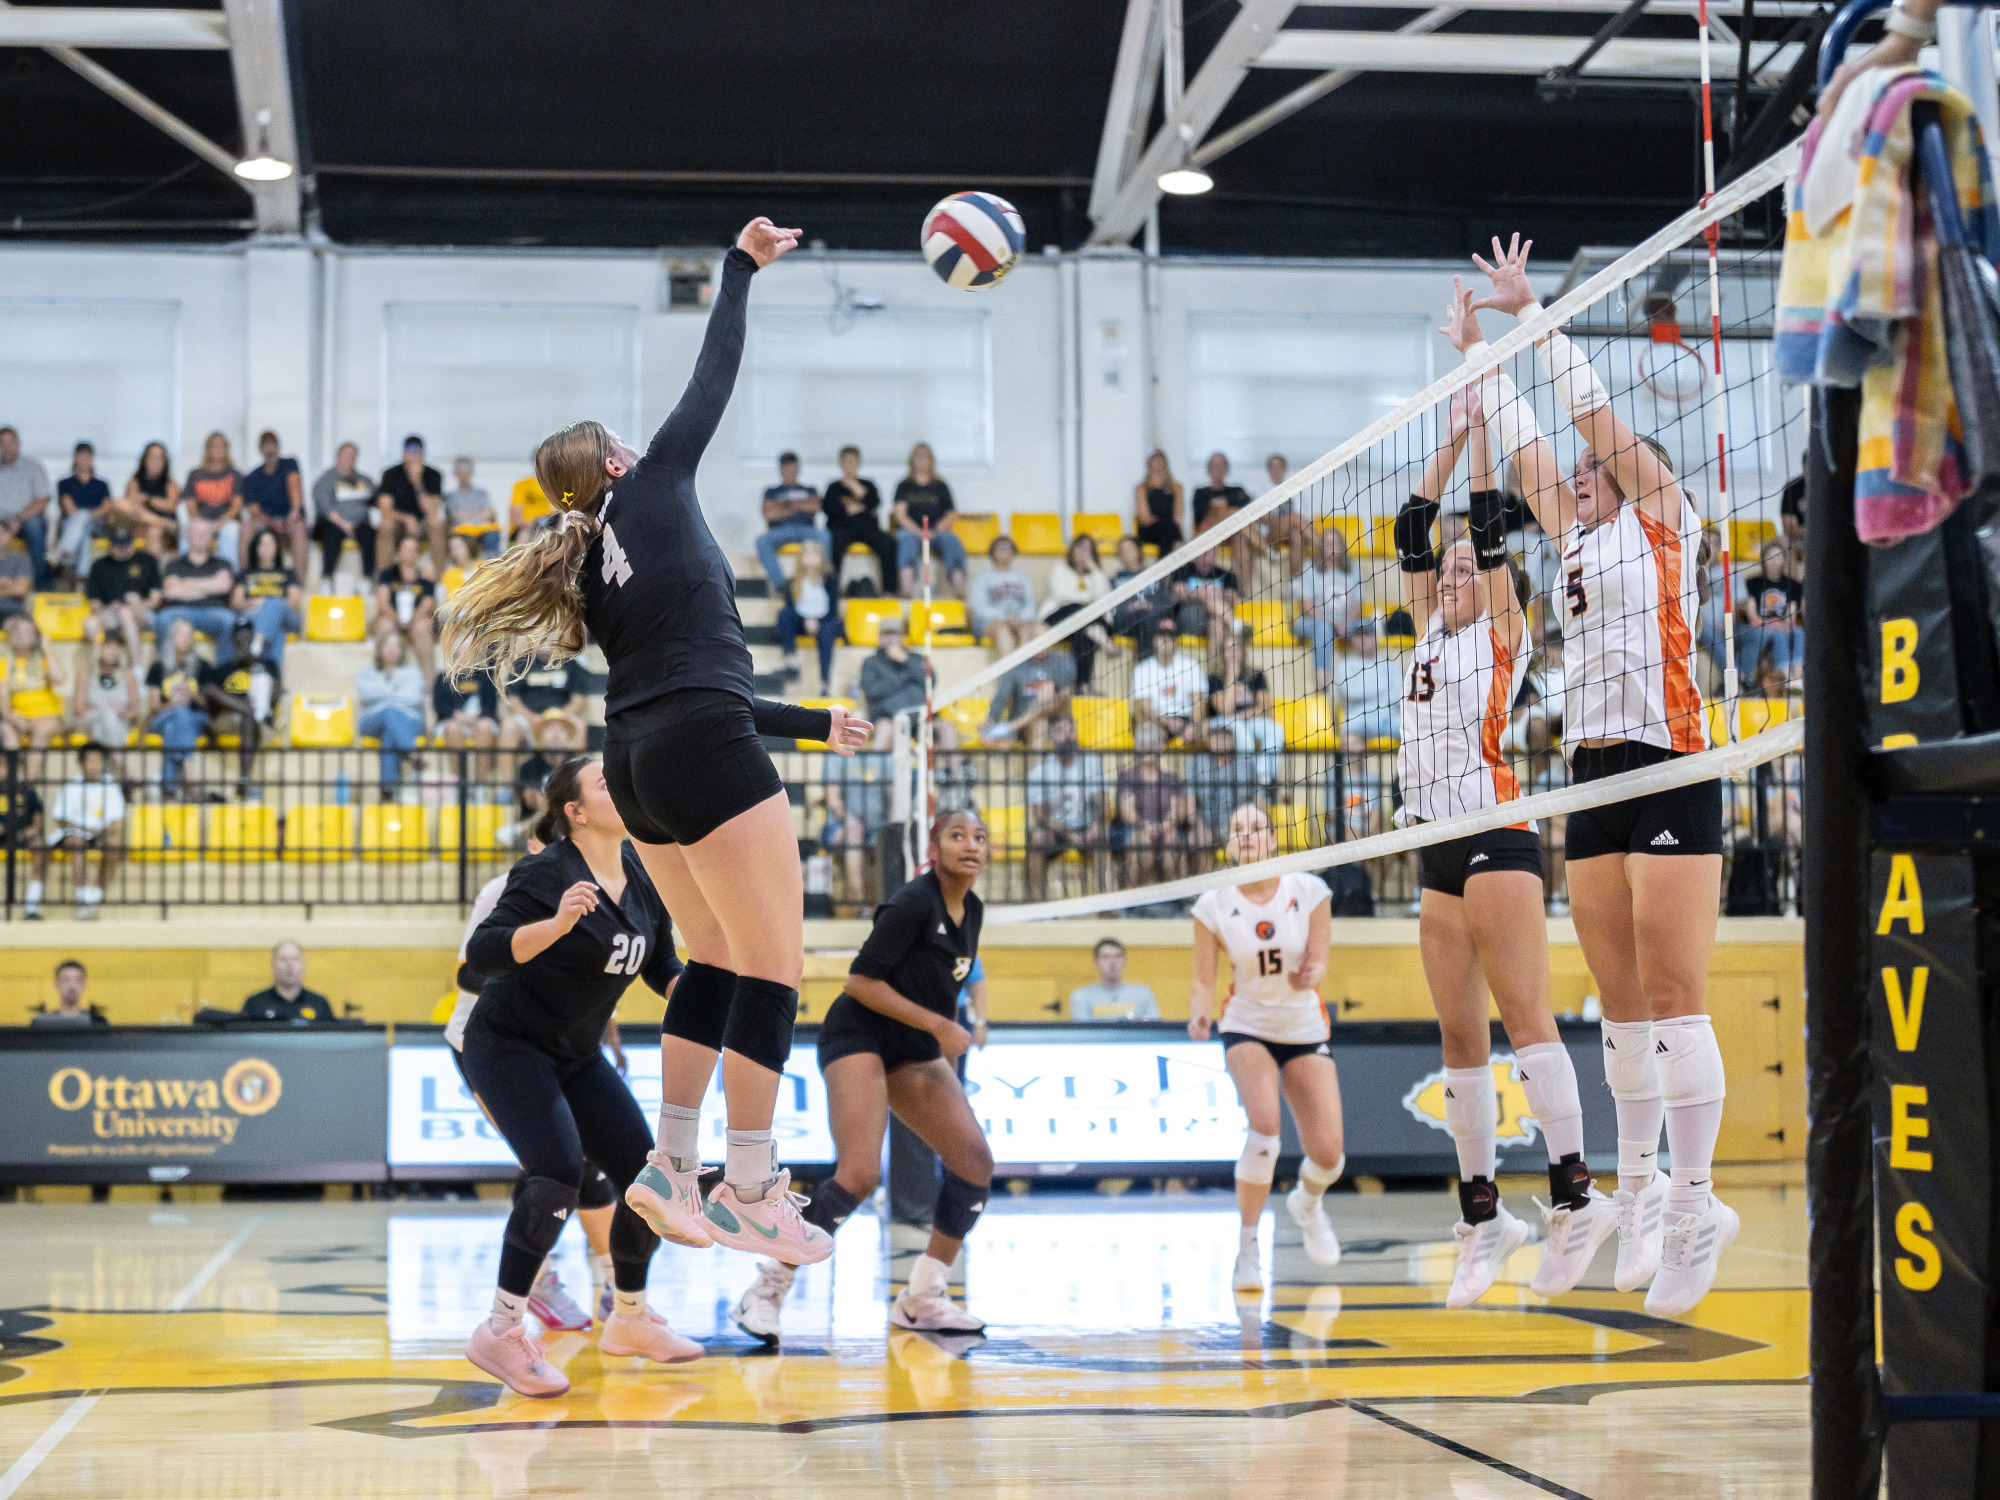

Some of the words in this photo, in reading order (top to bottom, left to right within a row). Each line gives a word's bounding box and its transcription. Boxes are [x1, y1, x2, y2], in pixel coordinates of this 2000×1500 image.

[602, 522, 633, 588] 4
[1566, 566, 1588, 618] 5
[1407, 660, 1435, 702] 13
[604, 933, 646, 976] 20
[1257, 948, 1283, 976] 15
[1874, 616, 1943, 1291] BAVES
[48, 1066, 220, 1112] Ottawa
[92, 1109, 240, 1145] University
